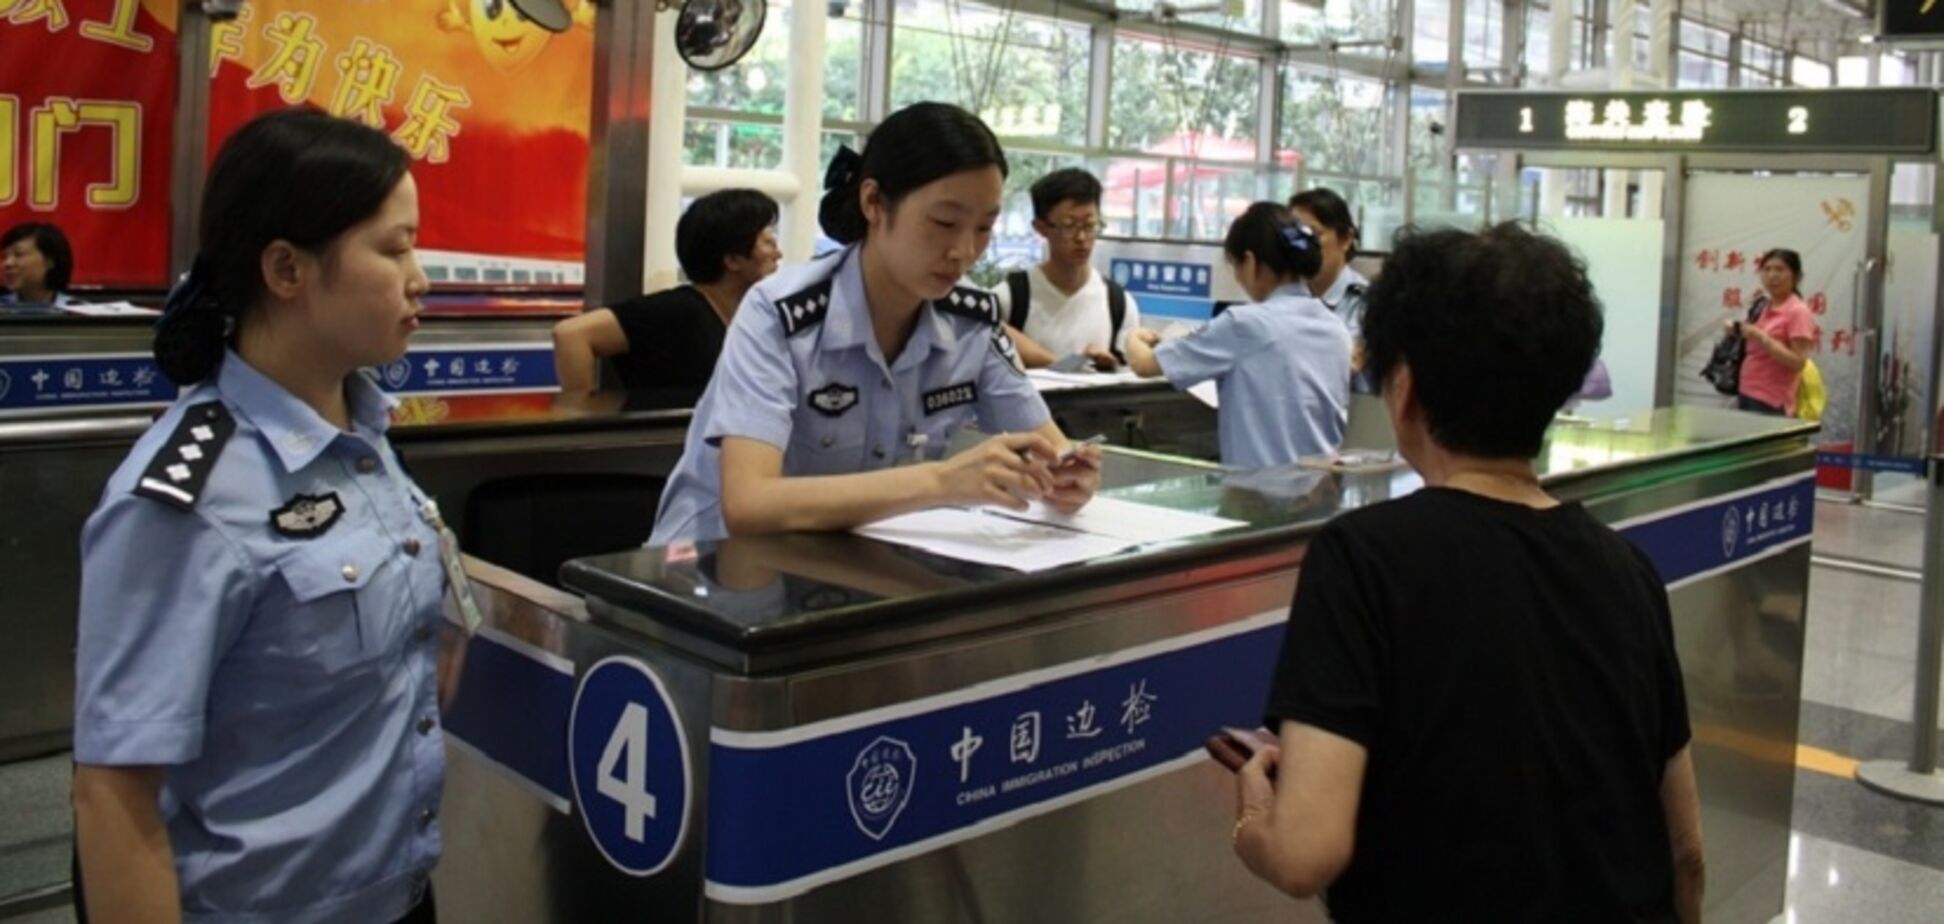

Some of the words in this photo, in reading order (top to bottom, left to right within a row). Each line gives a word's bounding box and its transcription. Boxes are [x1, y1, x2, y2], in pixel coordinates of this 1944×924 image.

[0, 95, 143, 211] 门
[1519, 106, 1533, 132] 1
[1787, 106, 1809, 133] 2
[597, 701, 657, 843] 4
[950, 677, 1158, 784] 中国边检
[956, 782, 997, 806] CHINA
[1001, 760, 1079, 793] IMMIGRATION
[1083, 738, 1147, 769] INSPECTION
